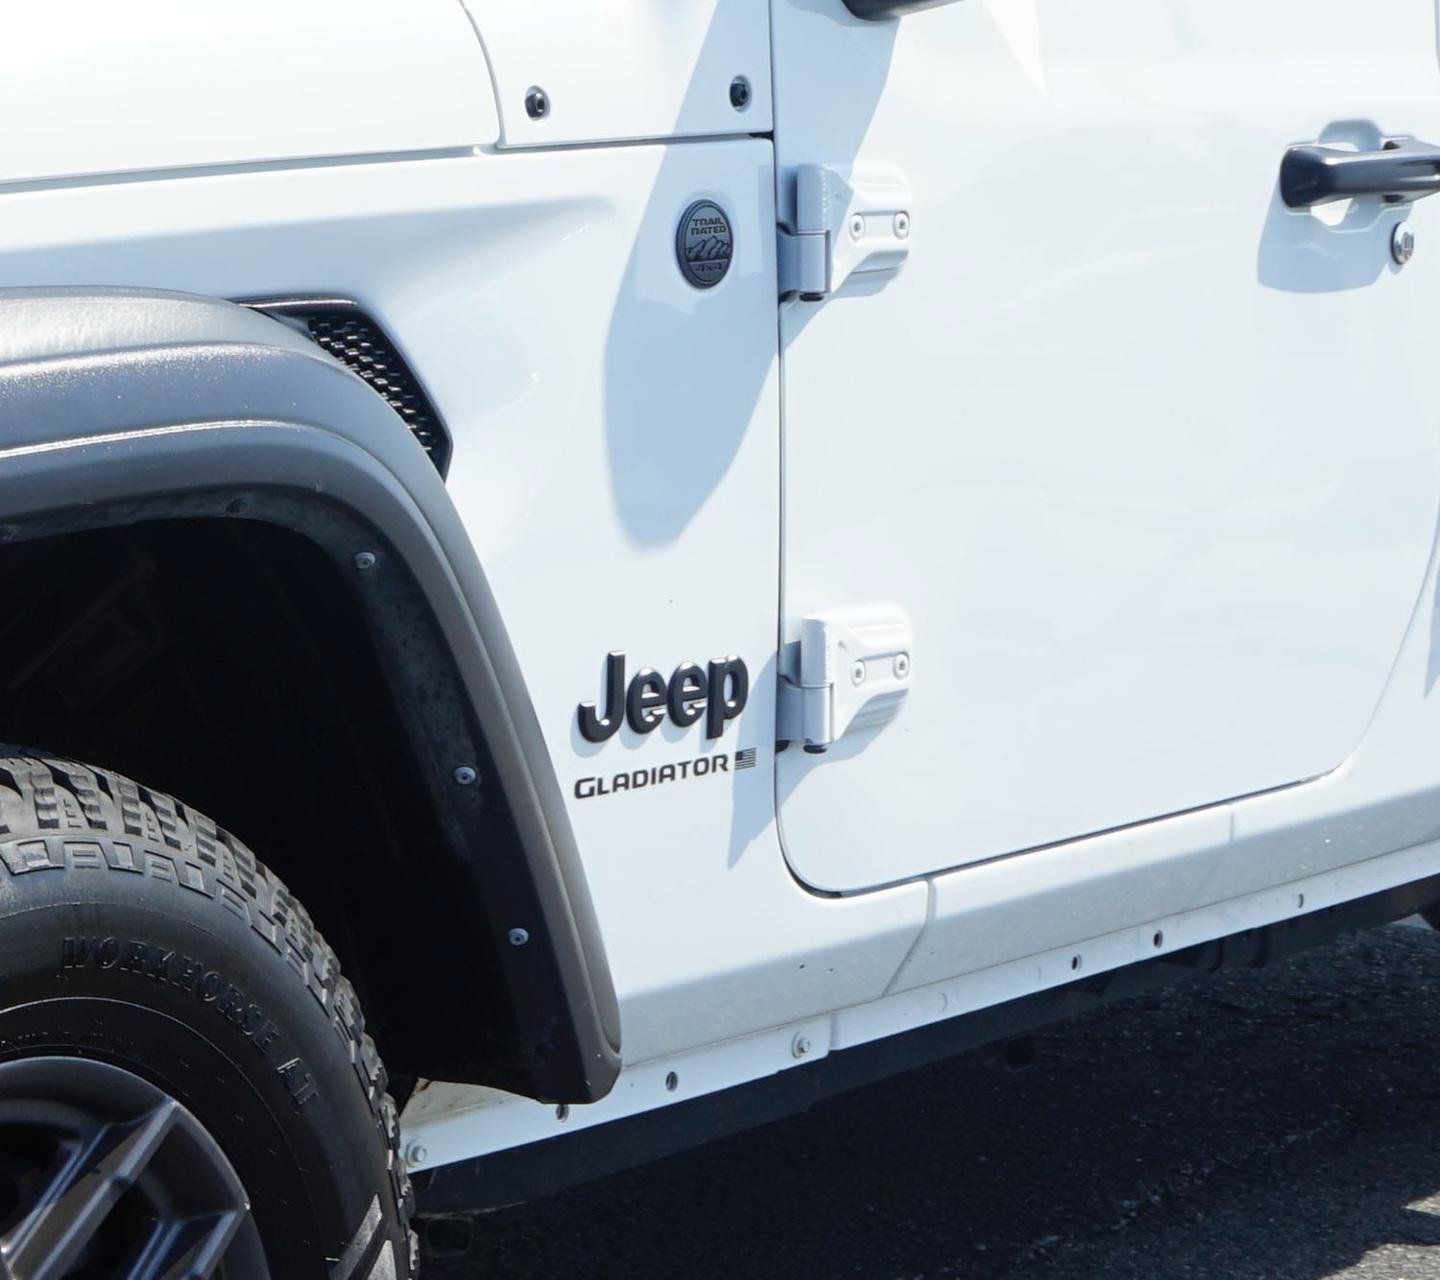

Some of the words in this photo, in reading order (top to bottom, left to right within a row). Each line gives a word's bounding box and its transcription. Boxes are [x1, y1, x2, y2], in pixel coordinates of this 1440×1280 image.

[691, 225, 726, 235] RATED
[692, 217, 723, 226] TRAIL
[577, 650, 748, 743] Jeep
[573, 757, 729, 800] GLADIATOR
